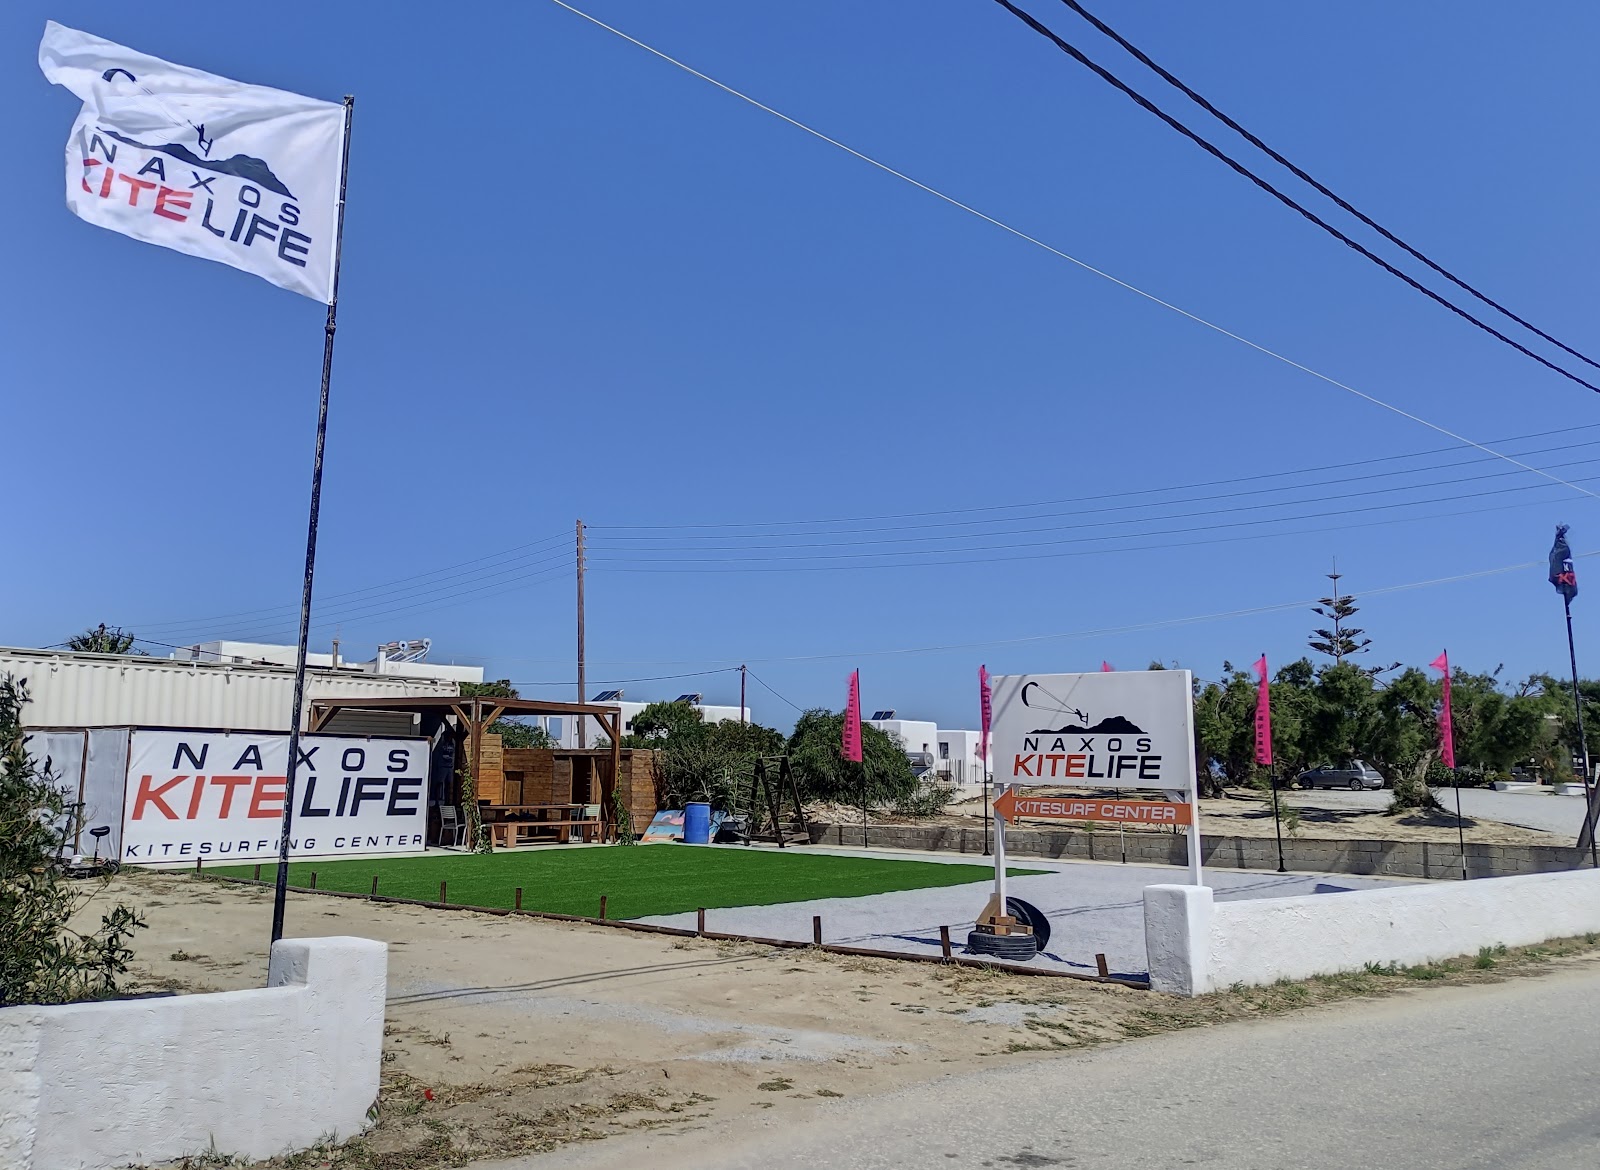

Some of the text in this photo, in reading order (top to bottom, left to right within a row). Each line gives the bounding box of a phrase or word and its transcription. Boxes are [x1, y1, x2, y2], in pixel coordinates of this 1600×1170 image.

[89, 133, 300, 226] NAXOS
[171, 742, 410, 773] NAXOS
[1023, 737, 1152, 753] NAXOS
[1013, 754, 1162, 780] KITELIFE
[131, 774, 423, 821] KITELIFE
[1014, 800, 1176, 821] KITESURF CENTER
[126, 834, 423, 858] KITESURFING CENTER
